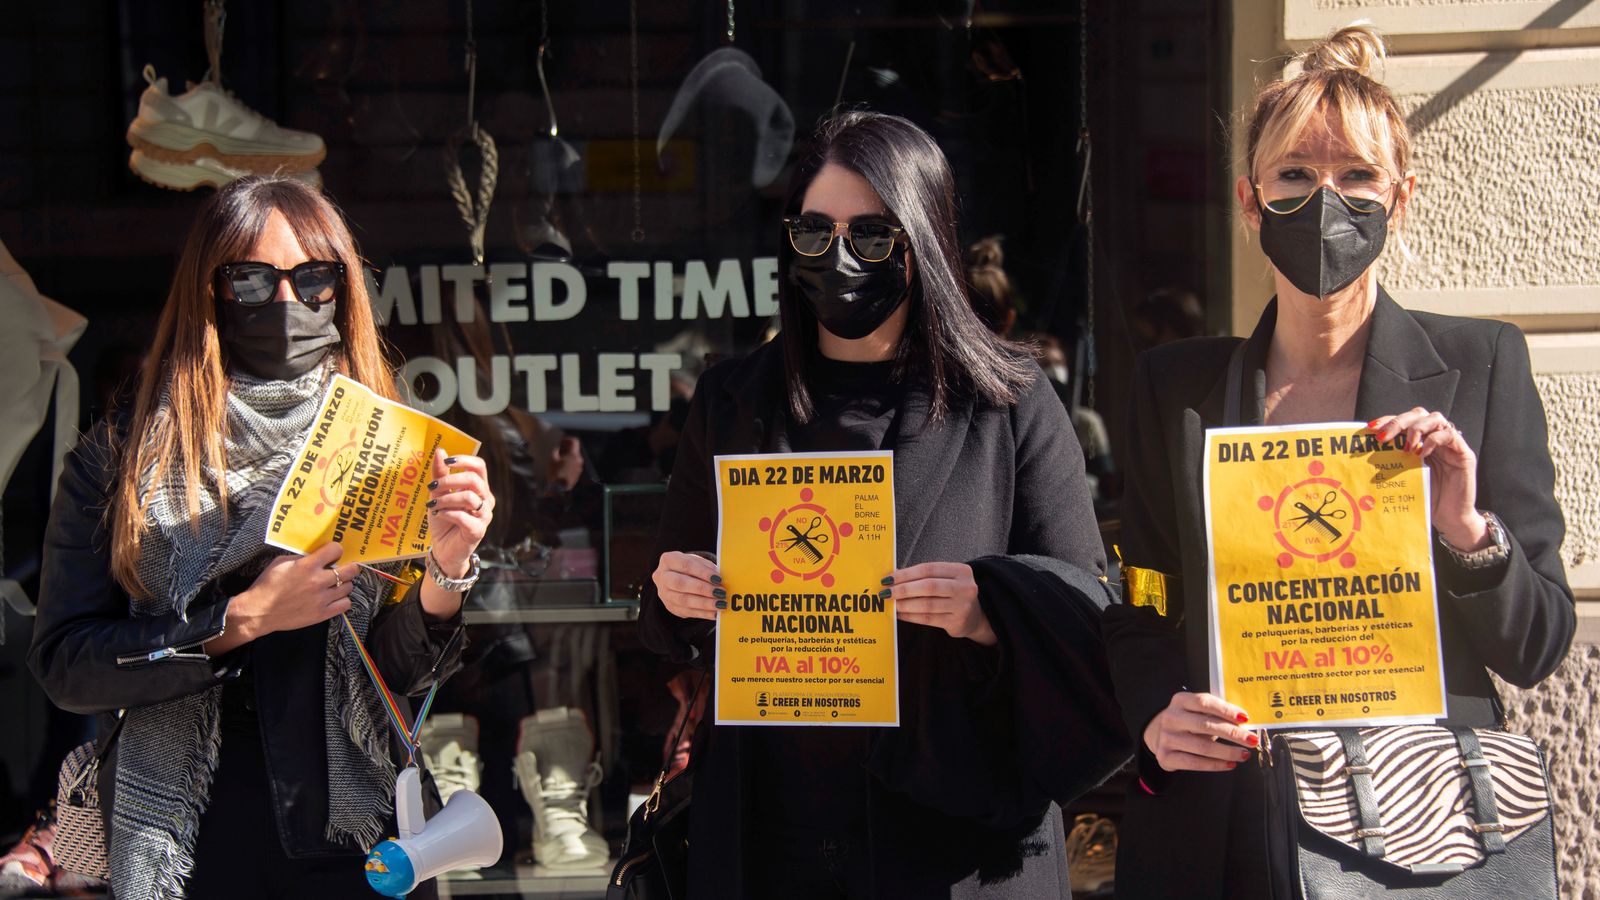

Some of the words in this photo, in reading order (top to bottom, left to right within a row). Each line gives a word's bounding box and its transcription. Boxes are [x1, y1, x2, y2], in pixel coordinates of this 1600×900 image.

[607, 257, 779, 321] TIME
[399, 353, 682, 417] OUTLET
[272, 503, 292, 534] DIA
[287, 477, 306, 500] 22
[300, 450, 319, 475] DE
[312, 387, 345, 447] MARZO
[1218, 442, 1256, 463] DIA
[1261, 440, 1290, 461] 22
[1296, 437, 1324, 458] DE
[399, 450, 426, 487] 10%
[729, 468, 761, 486] DIA
[765, 467, 787, 485] 22
[792, 466, 814, 485] DE
[820, 464, 885, 484] MARZO
[350, 443, 391, 532] NACIONAL
[381, 504, 387, 515] la
[384, 470, 399, 506] reducción
[396, 457, 404, 470] del
[1376, 481, 1407, 489] BORNE
[394, 490, 409, 510] al
[403, 506, 414, 531] nuestro
[411, 484, 421, 504] sector
[419, 471, 427, 484] por
[380, 512, 403, 547] IVA
[360, 545, 367, 556] de
[1228, 567, 1421, 603] CONCENTRACIÓN
[731, 589, 885, 613] CONCENTRACIÓN
[1267, 598, 1384, 625] NACIONAL
[762, 615, 854, 633] NACIONAL
[1242, 630, 1253, 638] de
[1256, 627, 1313, 638] peluquerías,
[1315, 624, 1360, 634] barberías
[1362, 624, 1368, 632] y
[1370, 621, 1413, 631] estéticas
[751, 636, 797, 646] peluquerías,
[794, 645, 832, 653] reducción
[834, 645, 845, 653] del
[1281, 638, 1297, 647] por
[1311, 633, 1357, 644] reducción
[1359, 633, 1375, 641] del
[756, 656, 791, 674] IVA
[796, 655, 814, 674] al
[818, 656, 861, 674] 10%
[1264, 650, 1307, 670] IVA
[1314, 647, 1335, 668] al
[1342, 644, 1394, 665] 10%
[1238, 675, 1254, 683] que
[1290, 671, 1323, 680] nuestro
[1325, 669, 1353, 678] sector
[1355, 669, 1371, 677] por
[1373, 667, 1386, 675] ser
[1389, 665, 1425, 674] esencial
[772, 698, 799, 707] CREER
[802, 698, 813, 707] EN
[815, 698, 861, 708] NOSOTROS
[1289, 695, 1322, 707] CREER
[1324, 693, 1338, 705] EN
[1341, 690, 1397, 704] NOSOTROS
